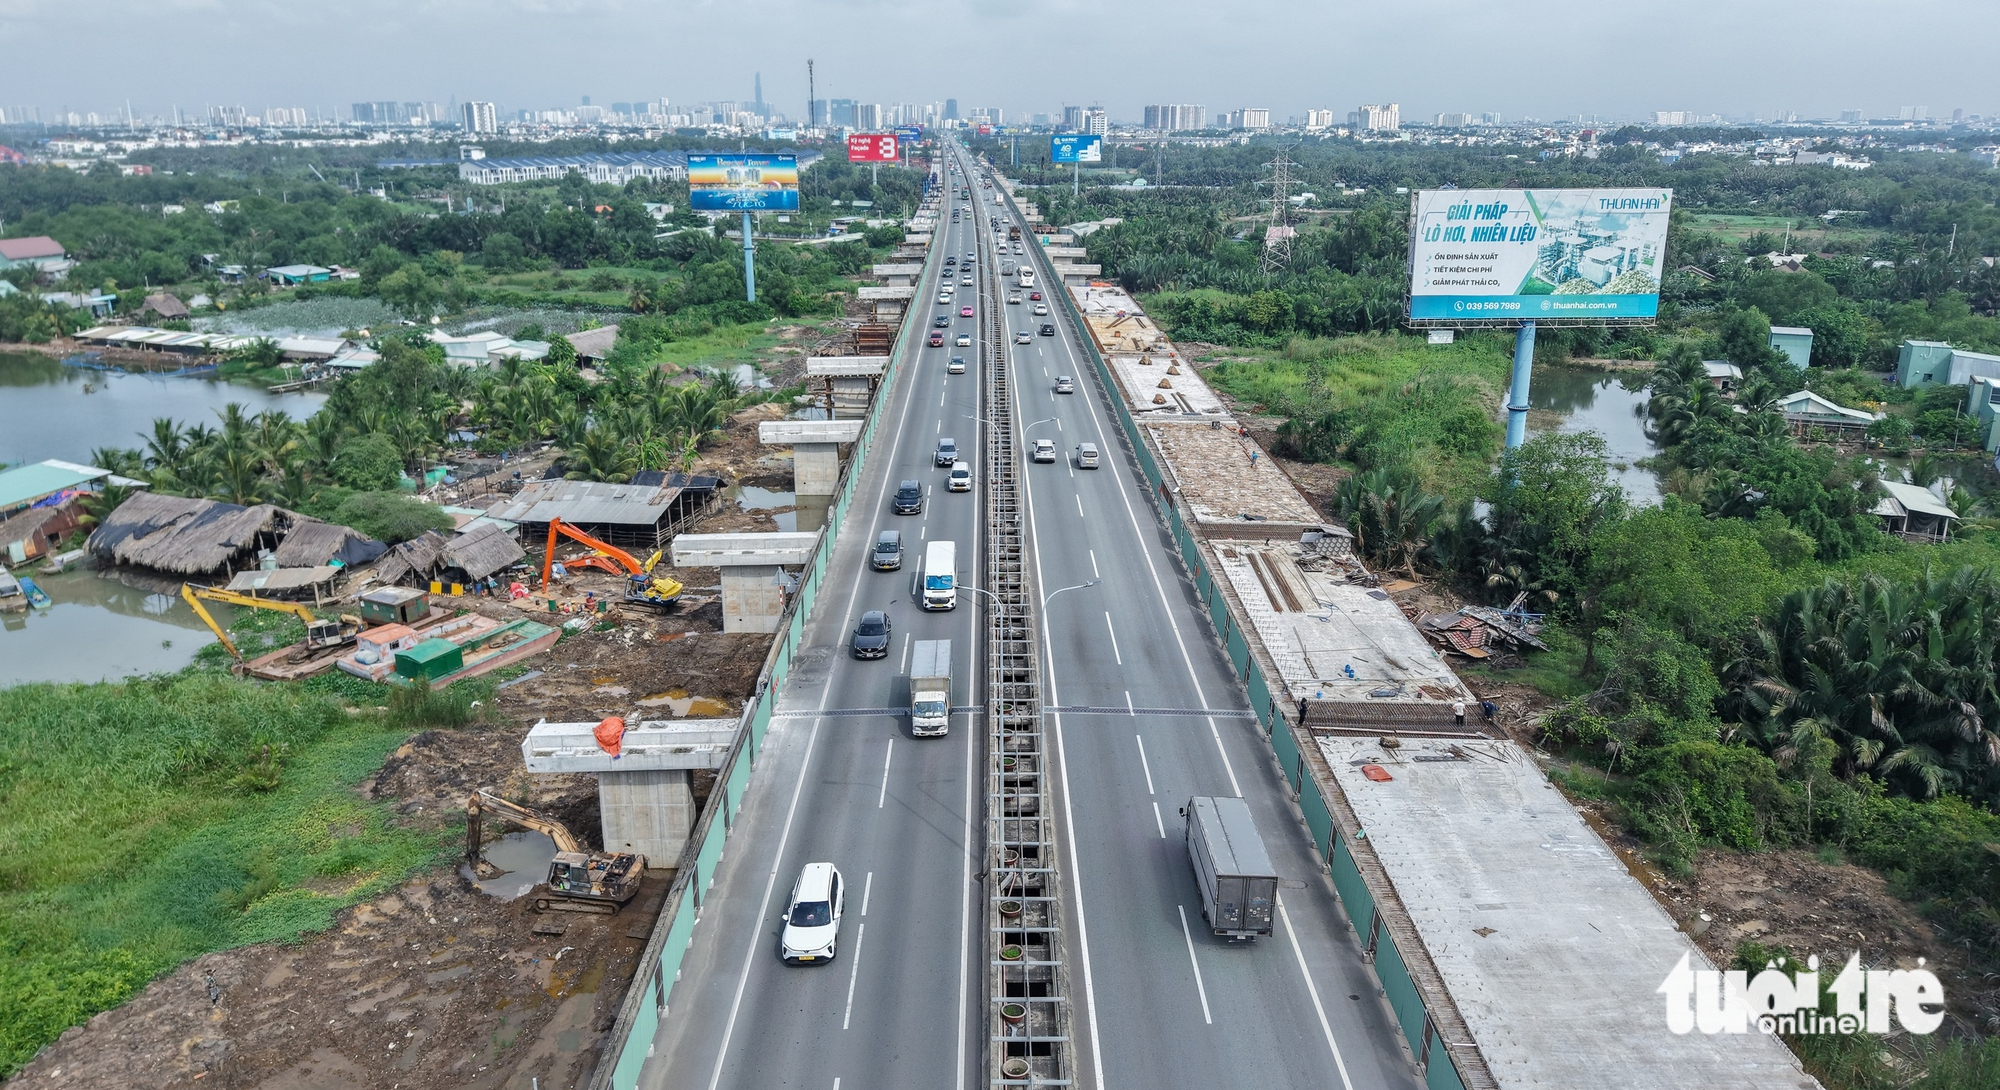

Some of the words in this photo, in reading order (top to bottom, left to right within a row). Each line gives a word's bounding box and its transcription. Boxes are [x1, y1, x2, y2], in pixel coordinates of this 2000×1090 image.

[1446, 200, 1473, 220] GIẢI
[1474, 200, 1508, 220] PHÁP
[1424, 224, 1441, 242] LÒ
[1470, 222, 1508, 242] NHIÊN
[1509, 222, 1537, 245] LIỆU
[1480, 252, 1498, 260] XUẤT
[1466, 302, 1482, 310] 039
[1484, 302, 1499, 310] 569
[1500, 302, 1520, 310] 7989
[1553, 301, 1617, 309] thuanhai.com.vn
